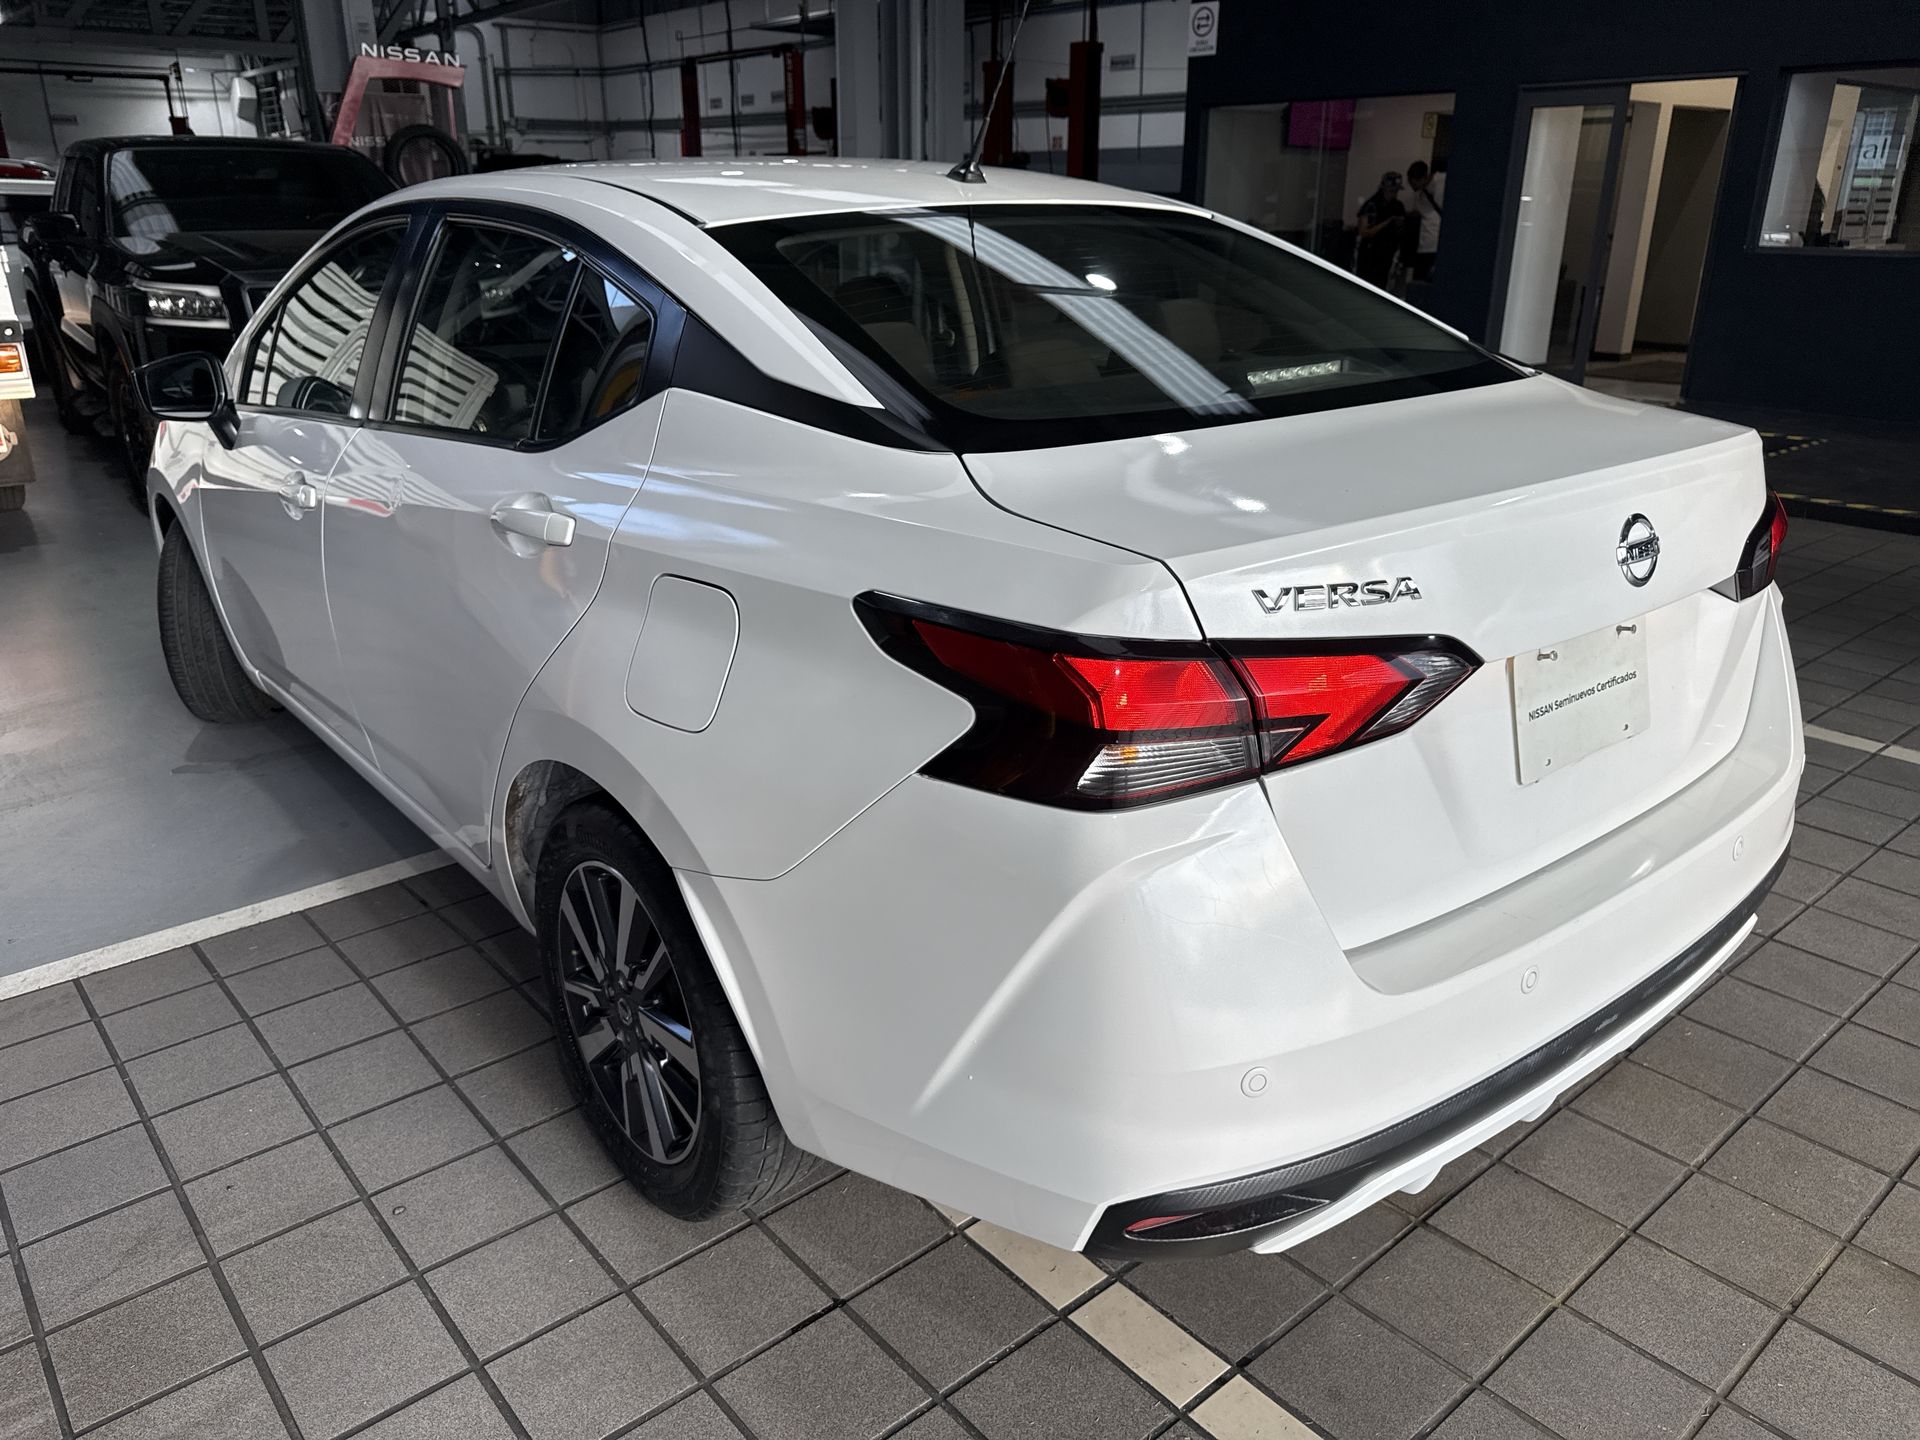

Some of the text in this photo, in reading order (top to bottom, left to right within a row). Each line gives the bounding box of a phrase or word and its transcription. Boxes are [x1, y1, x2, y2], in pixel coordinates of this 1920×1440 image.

[361, 42, 460, 67] NISSAN
[350, 135, 387, 148] NISS
[1252, 576, 1423, 614] VERSA
[1528, 670, 1637, 722] NISSAN Seminuevos Certificados
